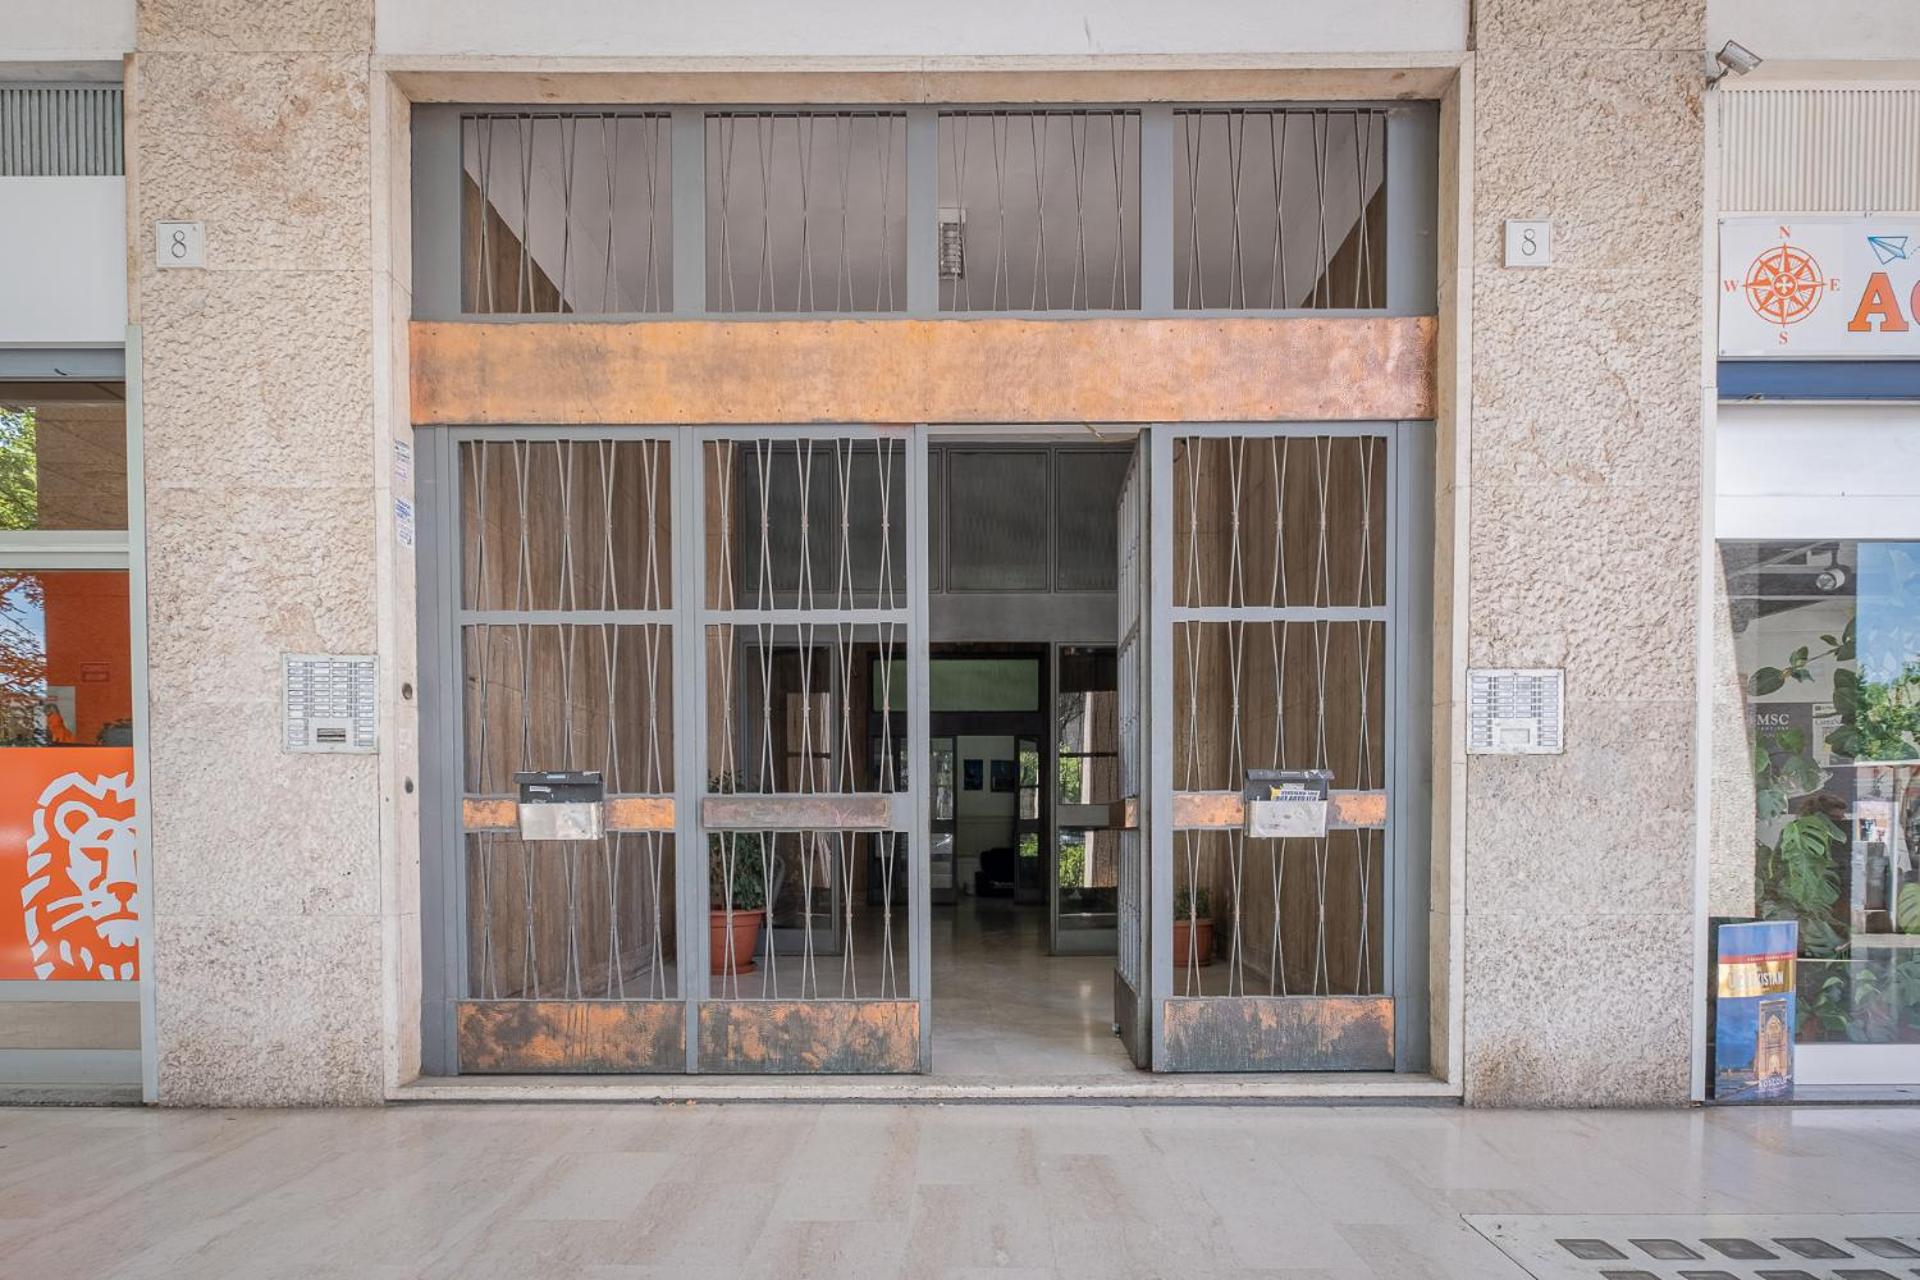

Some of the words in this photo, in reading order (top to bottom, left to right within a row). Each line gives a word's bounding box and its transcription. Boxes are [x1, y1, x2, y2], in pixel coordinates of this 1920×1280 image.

[1779, 226, 1791, 238] N
[171, 229, 187, 258] 8
[1522, 228, 1537, 256] 8
[1724, 280, 1739, 292] W
[1830, 279, 1841, 291] E
[1847, 272, 1920, 333] A
[1778, 332, 1788, 345] S
[1757, 714, 1790, 725] MSC
